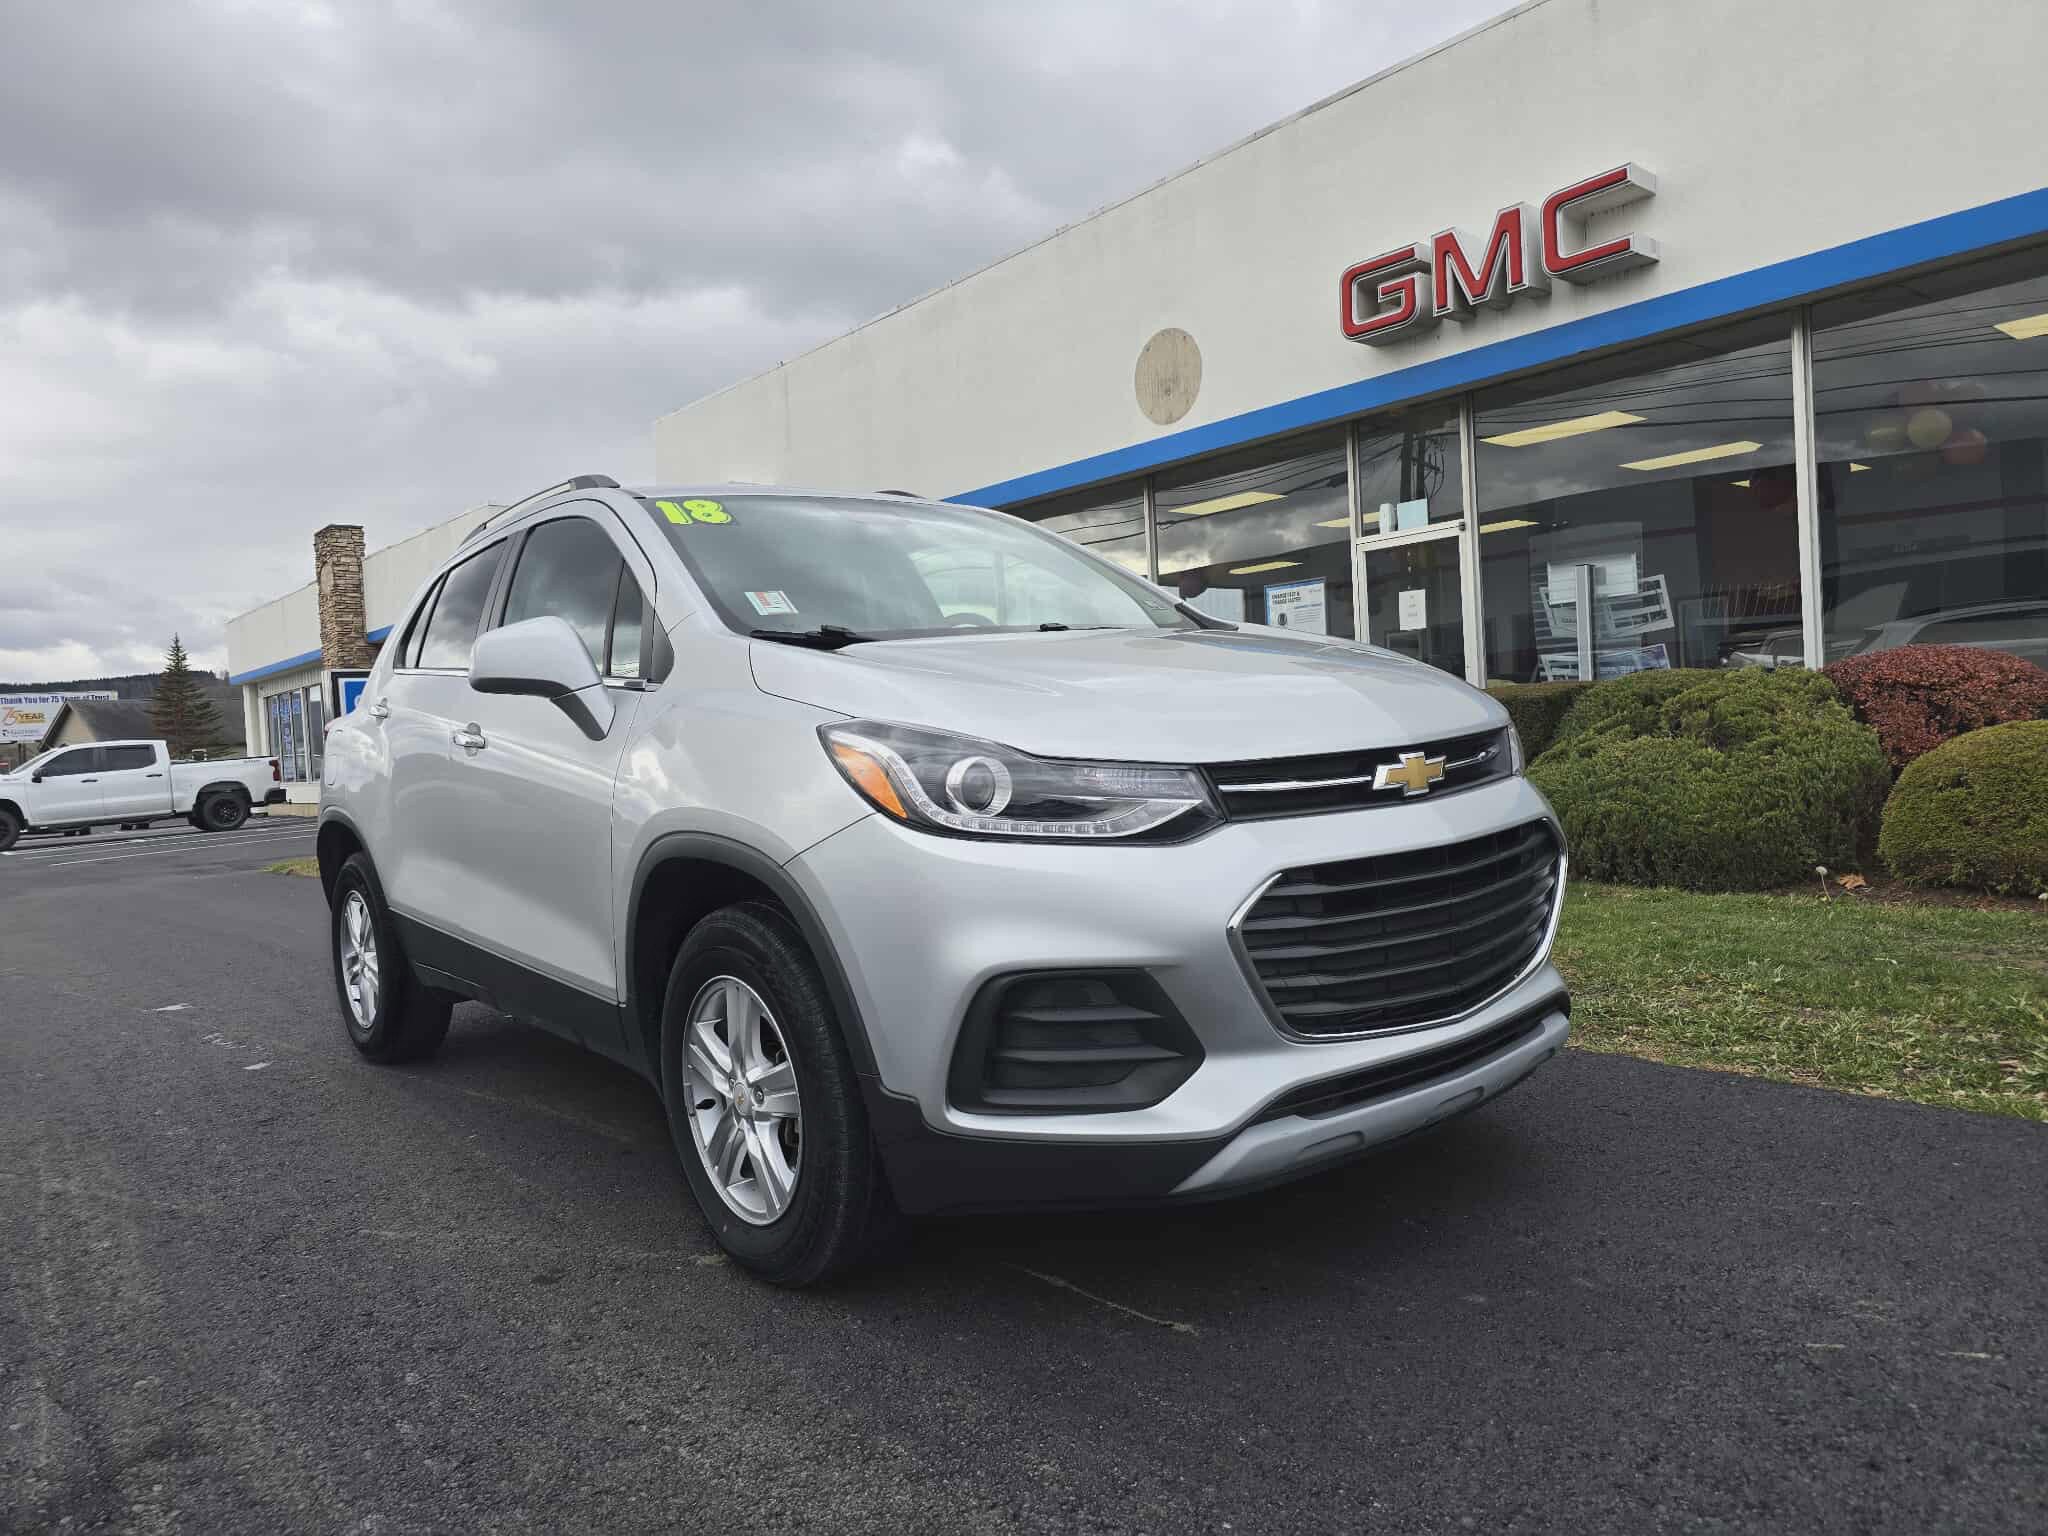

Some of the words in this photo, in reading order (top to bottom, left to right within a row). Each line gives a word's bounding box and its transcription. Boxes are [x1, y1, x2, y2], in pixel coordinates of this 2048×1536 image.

[1340, 162, 1656, 342] GMC
[656, 500, 732, 525] 18
[24, 696, 39, 704] You
[50, 695, 60, 704] 75
[18, 712, 45, 720] YEAR
